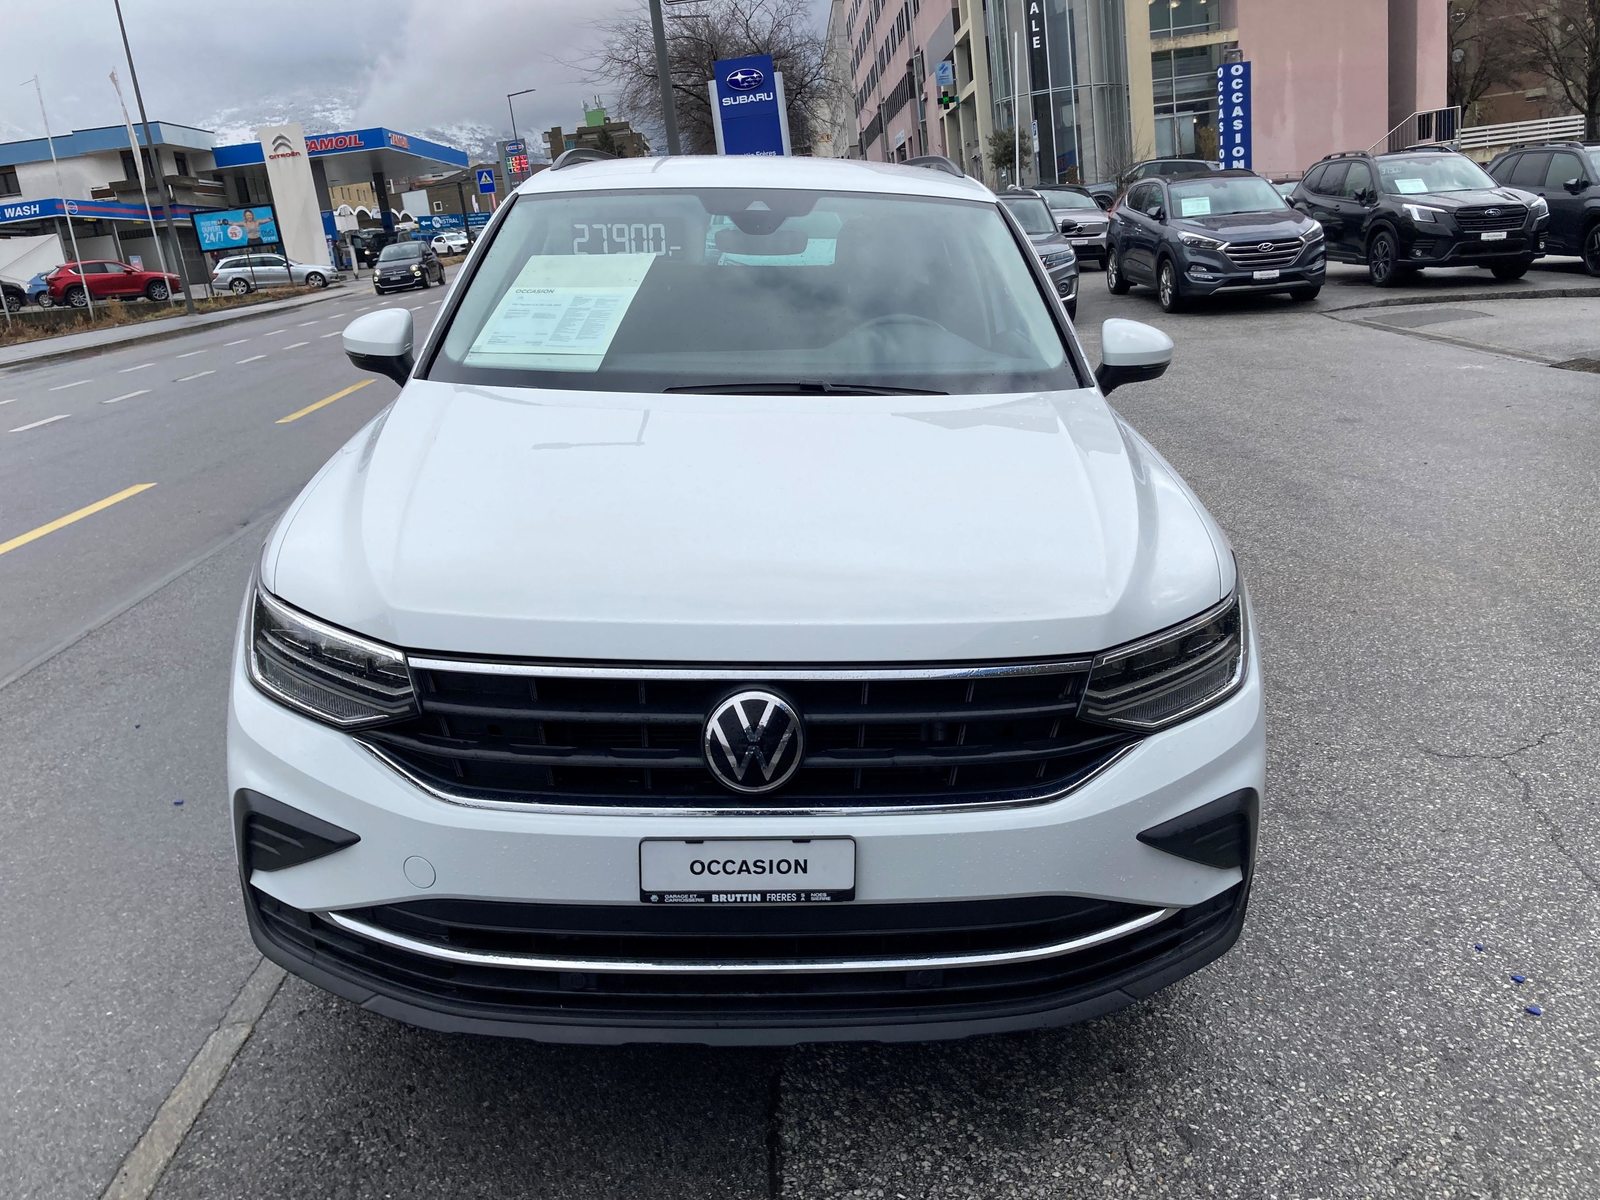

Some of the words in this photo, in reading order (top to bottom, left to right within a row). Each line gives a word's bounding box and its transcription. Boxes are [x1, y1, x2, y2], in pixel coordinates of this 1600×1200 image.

[722, 92, 773, 106] SUBARU
[1217, 66, 1225, 169] OCCASION
[1231, 64, 1245, 168] OCCASION
[4, 204, 40, 218] WASH
[689, 858, 808, 875] OCCASION
[711, 893, 761, 902] BRUTTIN
